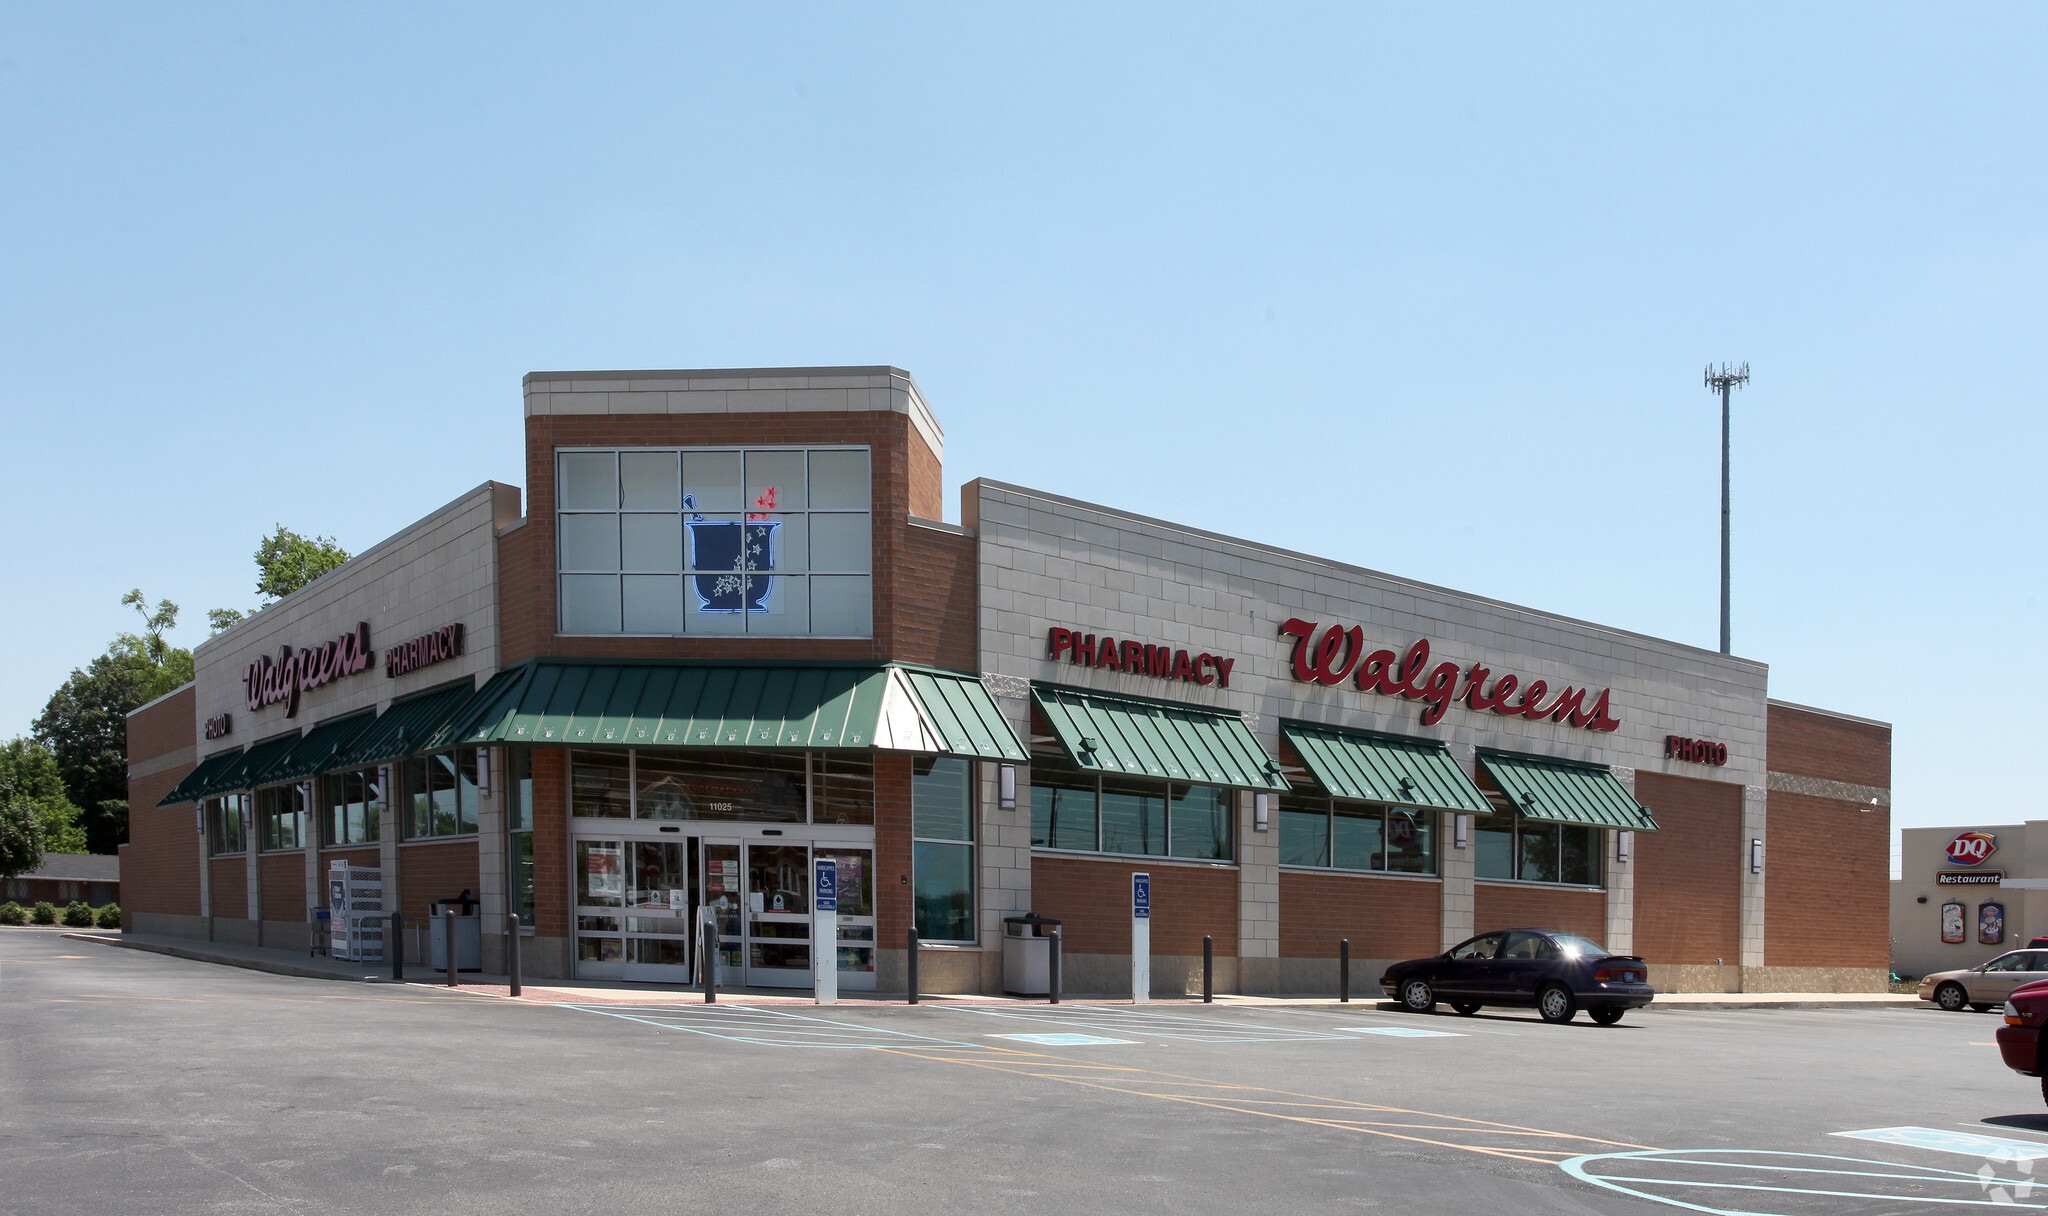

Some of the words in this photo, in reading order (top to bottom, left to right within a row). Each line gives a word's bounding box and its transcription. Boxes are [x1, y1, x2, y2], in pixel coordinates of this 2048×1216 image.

[385, 623, 462, 678] PHARMACY
[1048, 627, 1235, 688] PHARMACY
[242, 621, 372, 719] Walgreens
[1279, 618, 1620, 732] Walgreens
[205, 713, 229, 739] PHOTO
[1667, 735, 1728, 766] PHOTO
[709, 803, 733, 811] 11025
[1952, 838, 1987, 858] DQ
[1939, 875, 2000, 883] Restaurant
